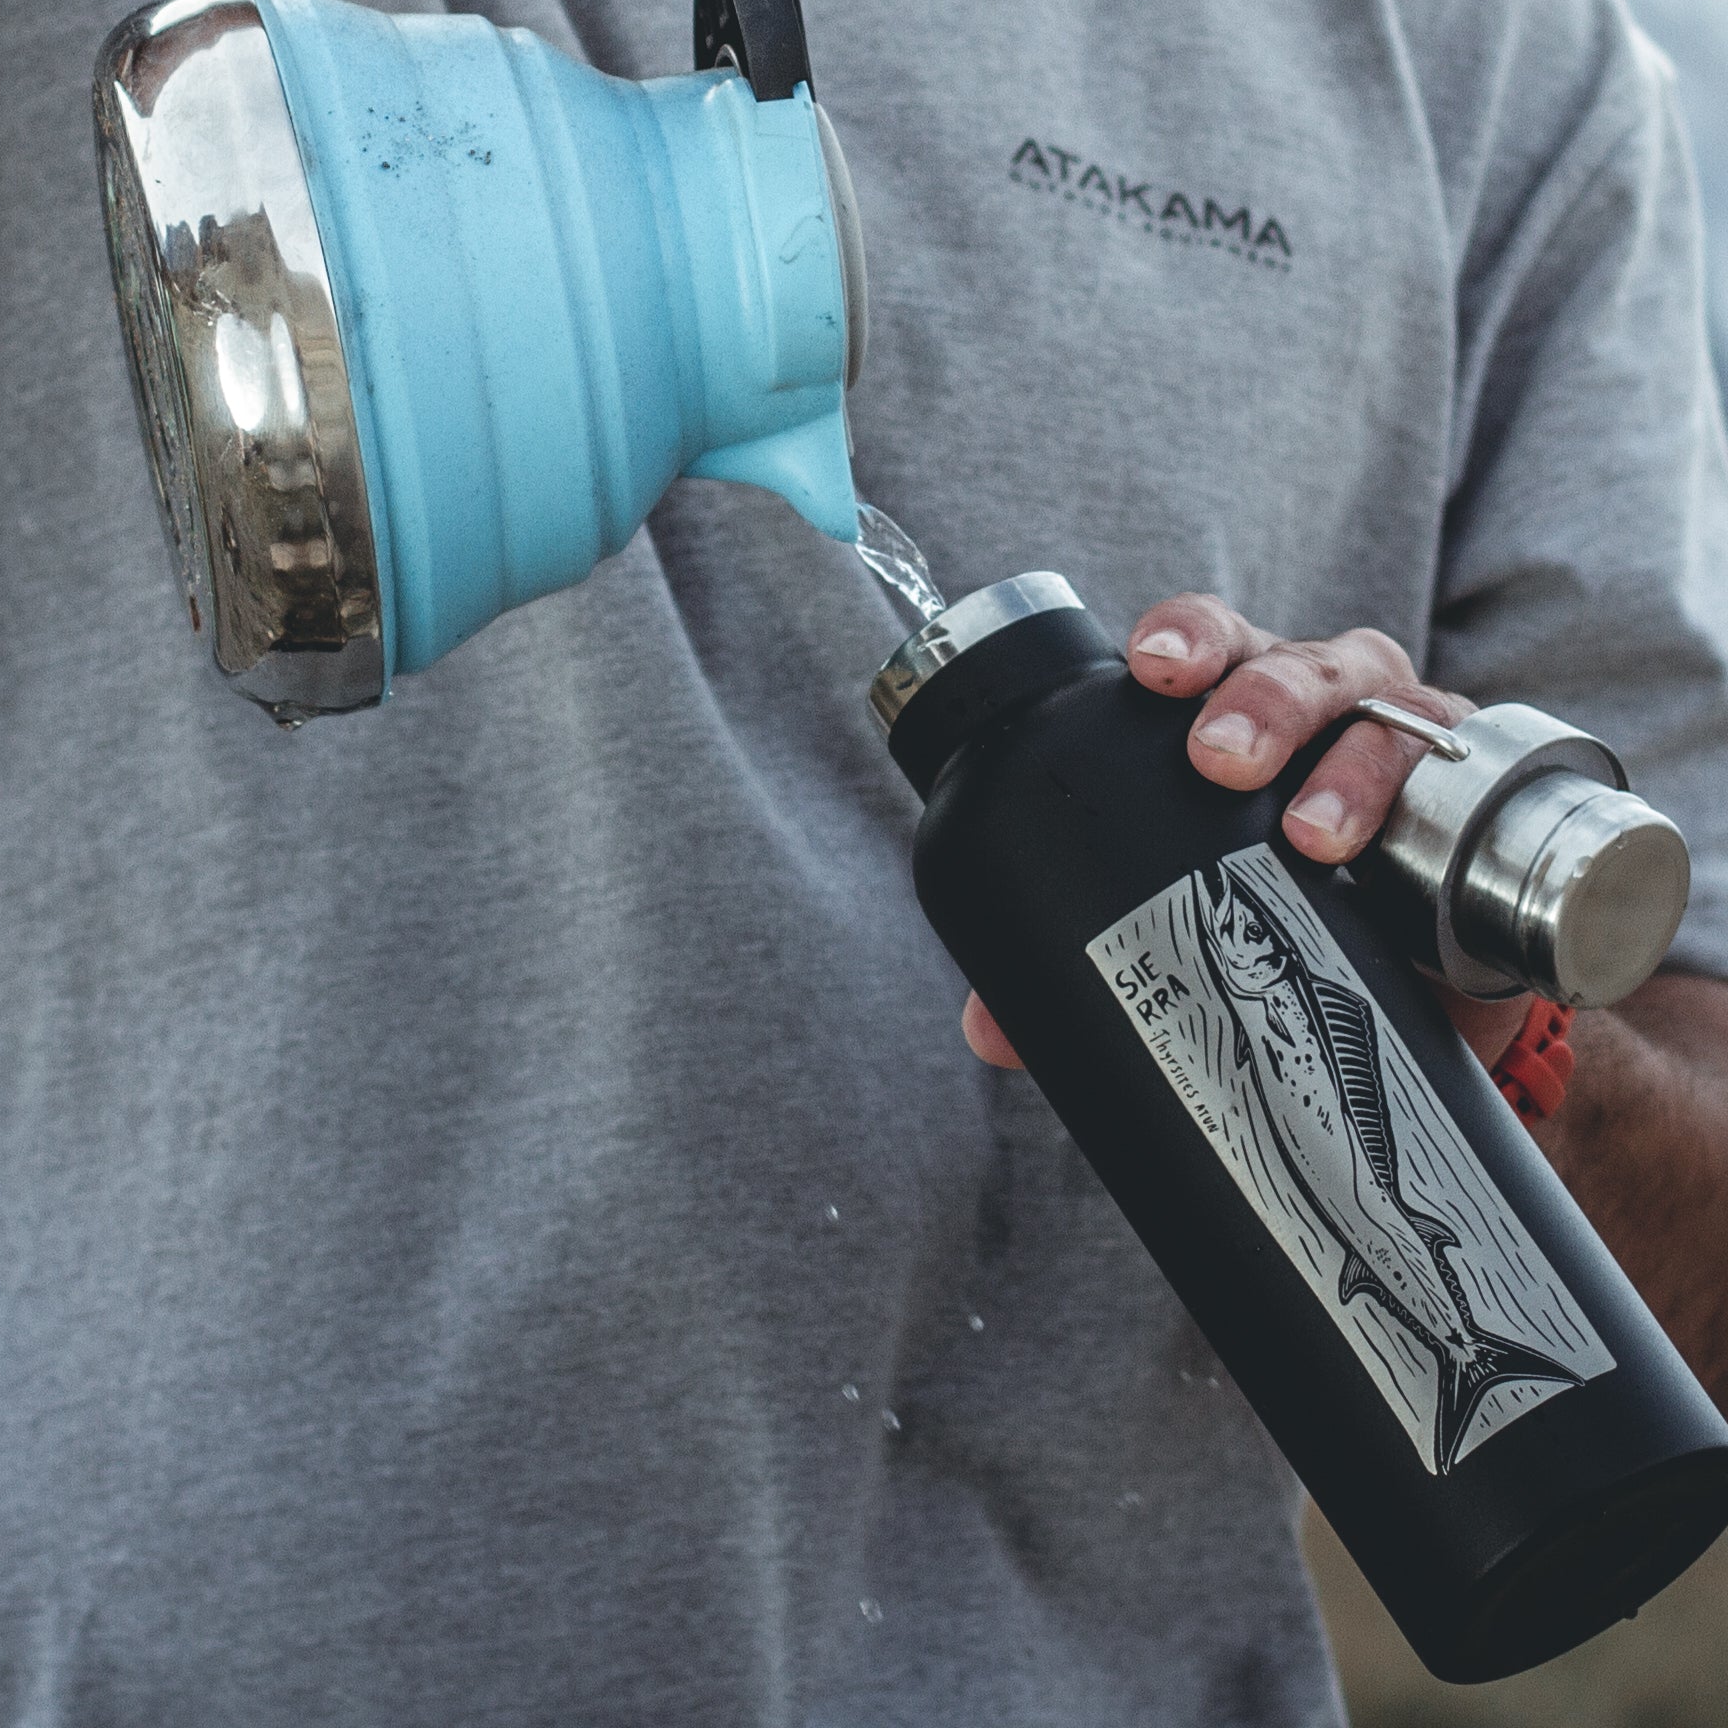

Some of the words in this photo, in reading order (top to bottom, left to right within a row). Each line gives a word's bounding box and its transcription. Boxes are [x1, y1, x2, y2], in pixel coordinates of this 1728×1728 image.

[1010, 137, 1293, 257] ATAKAMA
[1115, 951, 1161, 1001] SIE
[1135, 973, 1191, 1027] RRA
[1194, 1103, 1220, 1134] ATUN
